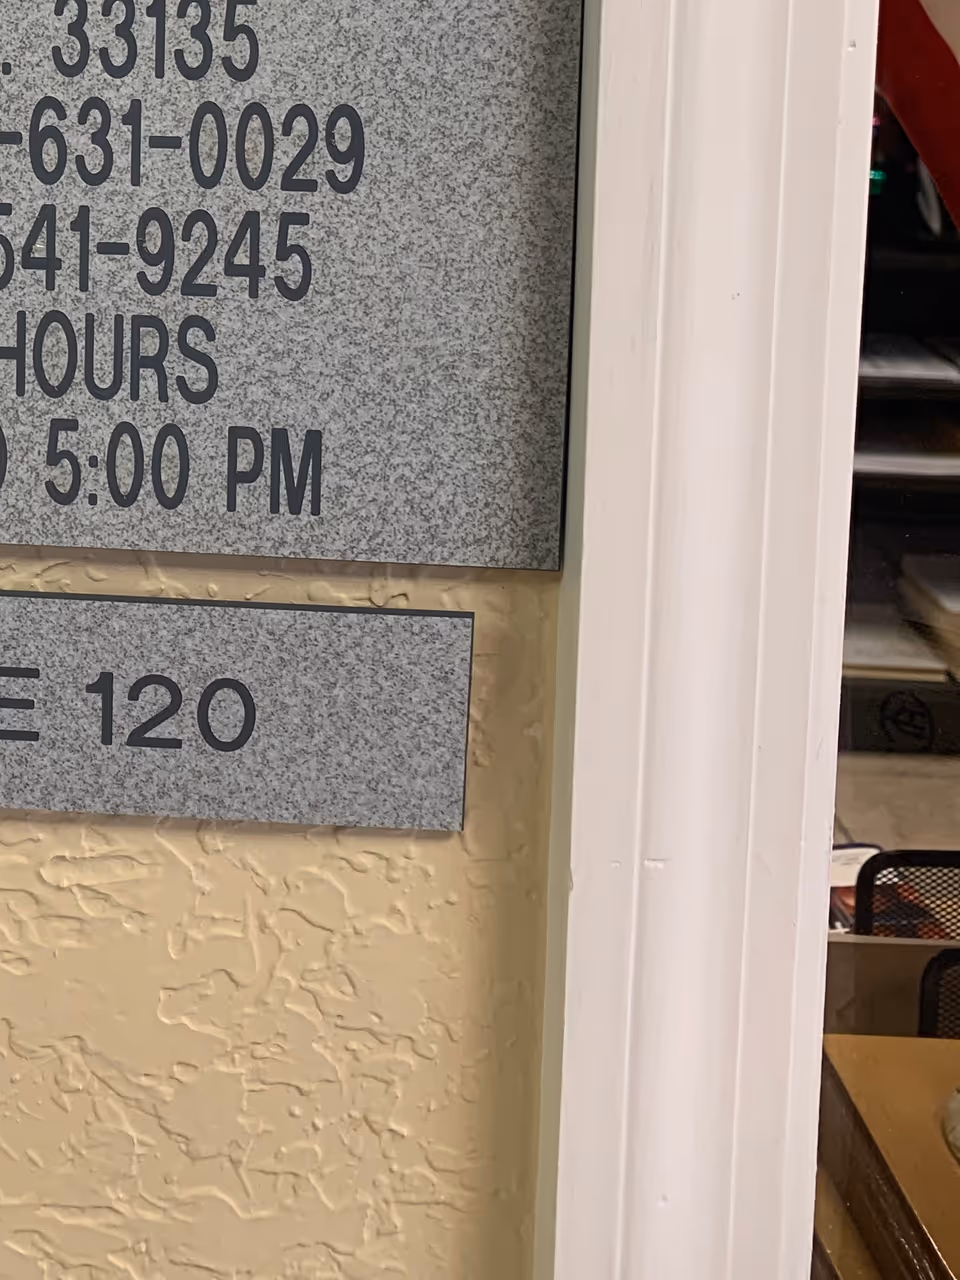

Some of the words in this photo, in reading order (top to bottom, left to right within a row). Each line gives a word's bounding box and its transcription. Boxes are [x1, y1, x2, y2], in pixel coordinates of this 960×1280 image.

[45, 418, 190, 510] 5:00
[226, 425, 323, 517] PM
[85, 671, 257, 753] 120
